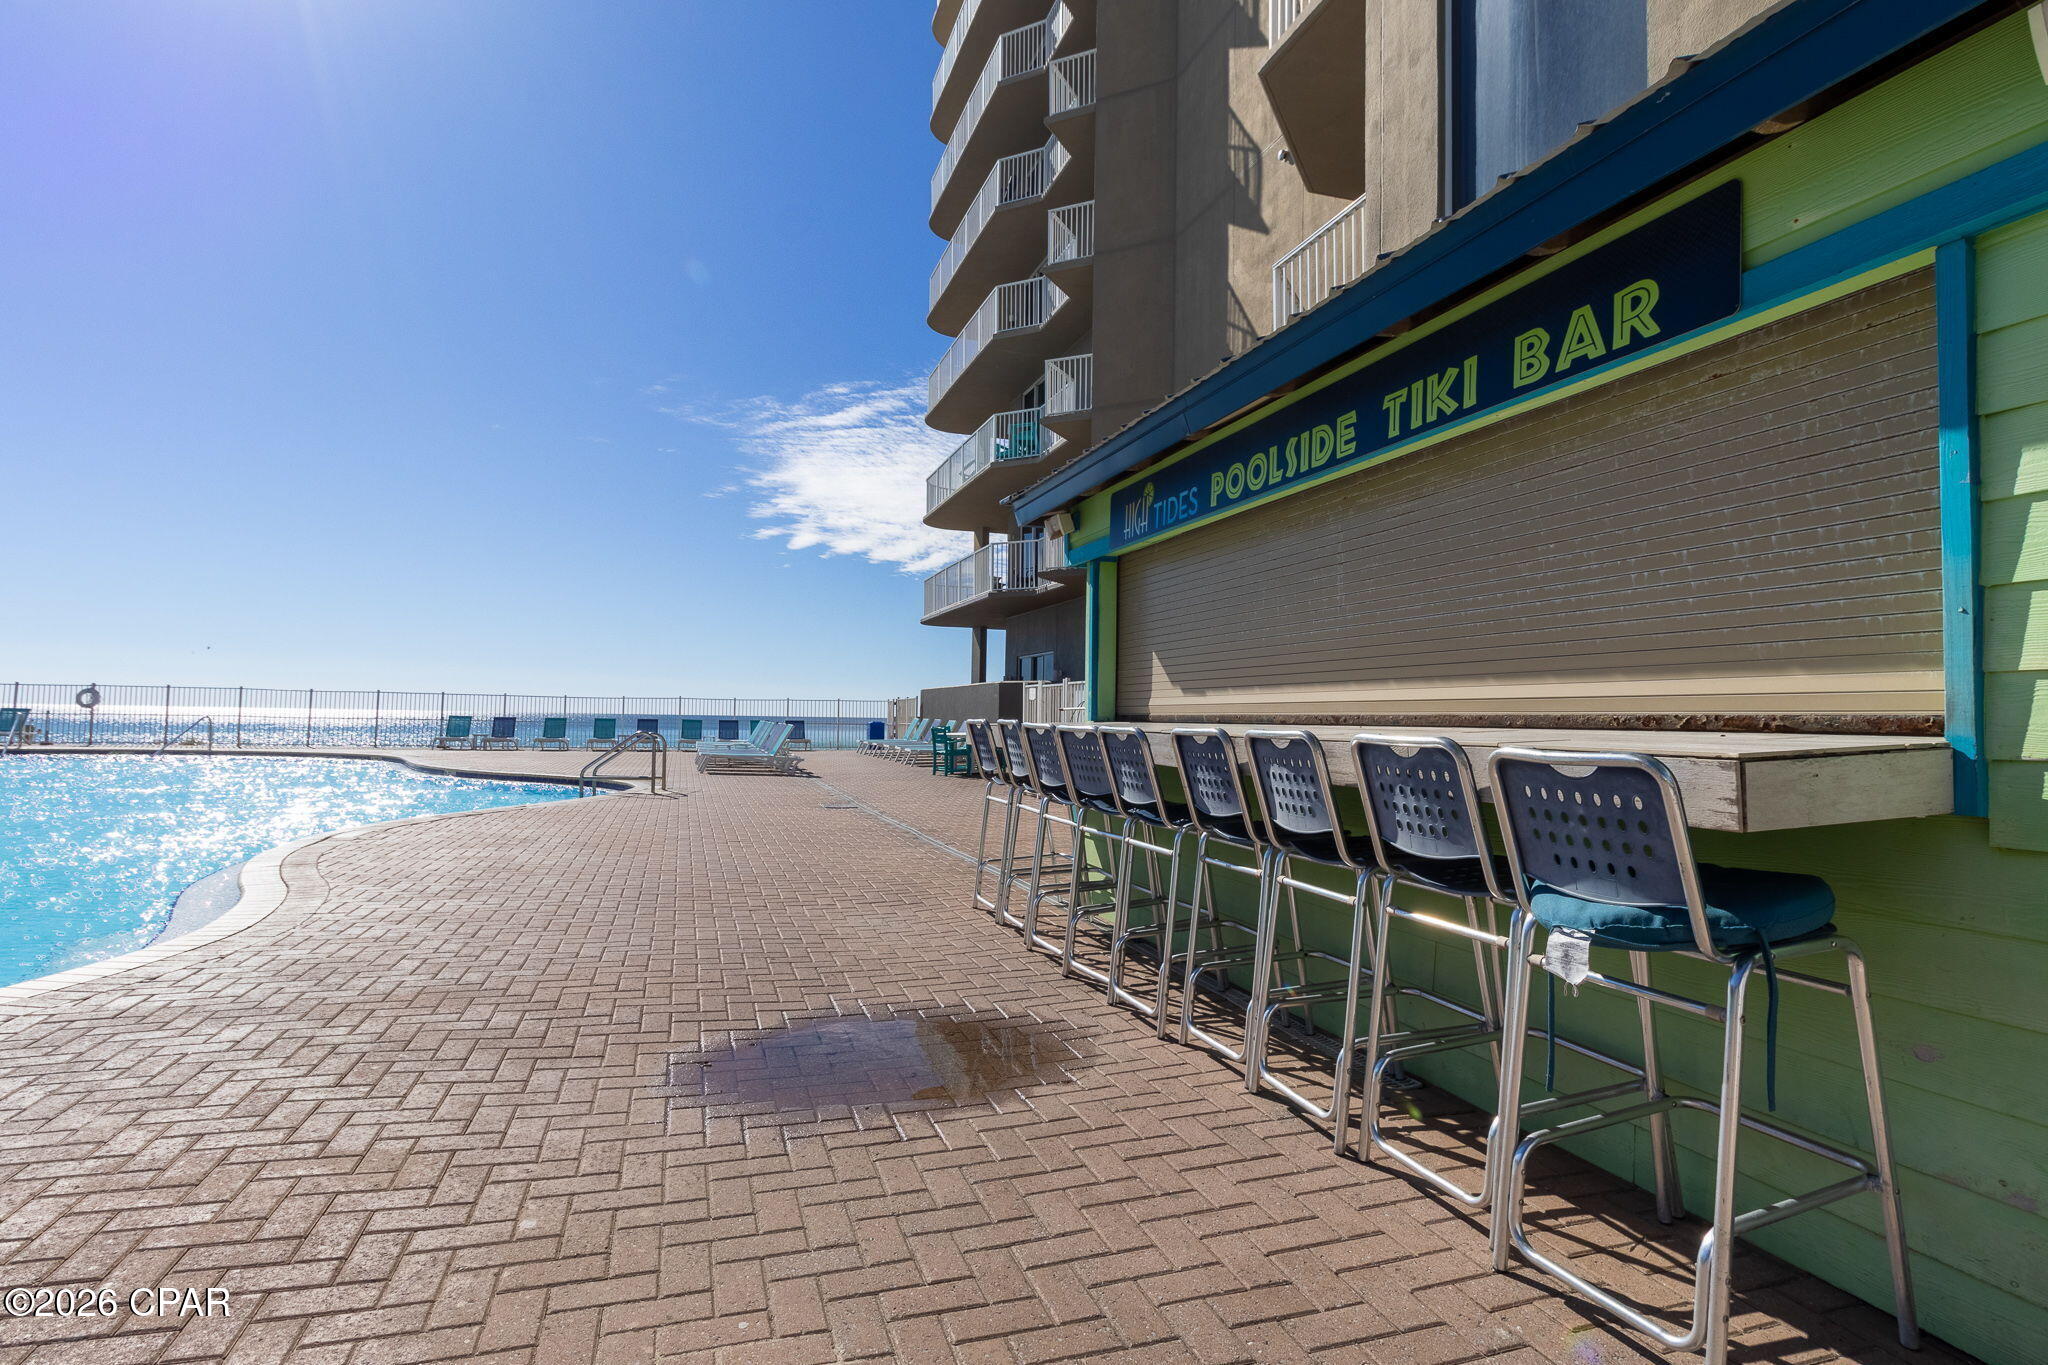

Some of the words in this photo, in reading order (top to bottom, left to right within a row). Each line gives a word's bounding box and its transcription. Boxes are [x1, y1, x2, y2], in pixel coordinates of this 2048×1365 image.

[1123, 494, 1149, 541] HIGH
[1154, 486, 1198, 529] TIDES
[1210, 411, 1356, 507] POOLSIDE
[1383, 355, 1477, 439] TIKI
[1513, 279, 1660, 389] BAR
